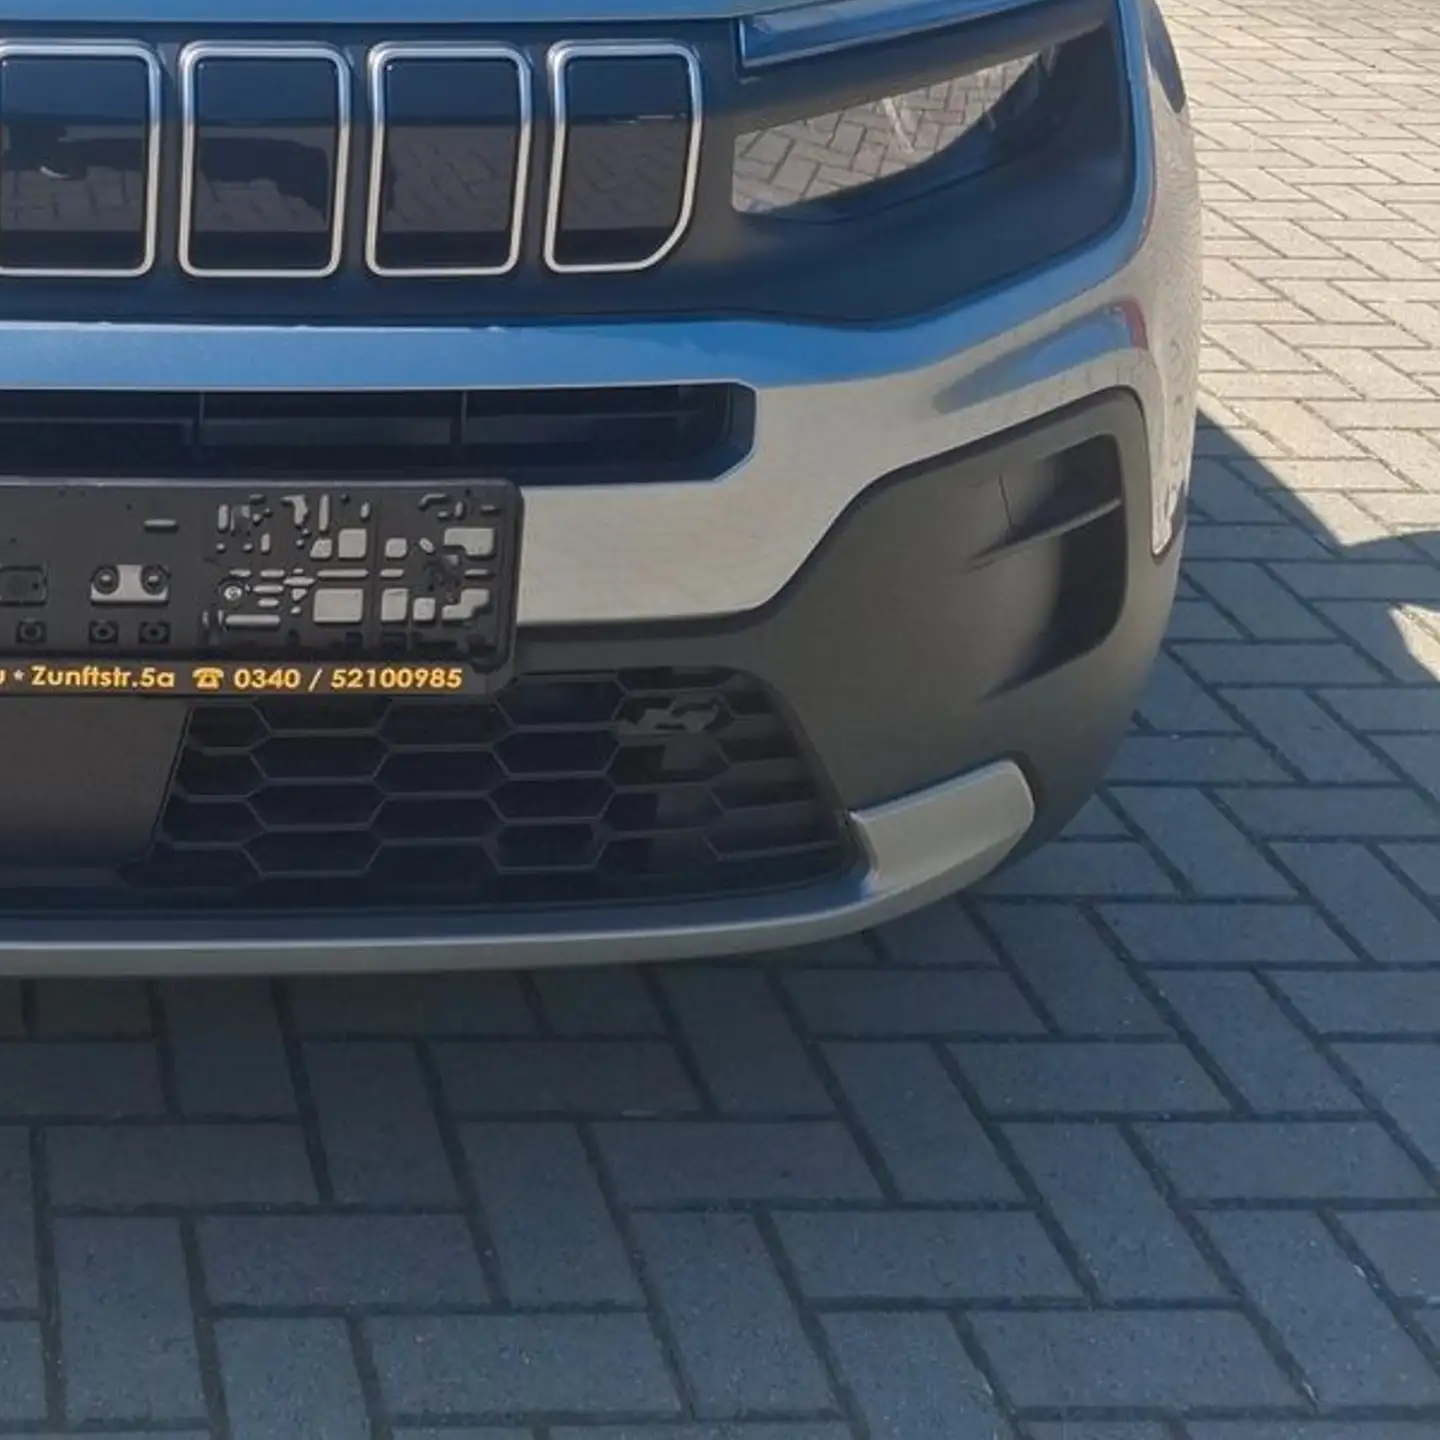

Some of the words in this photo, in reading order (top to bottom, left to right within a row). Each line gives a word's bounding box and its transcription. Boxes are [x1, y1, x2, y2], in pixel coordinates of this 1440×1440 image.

[30, 665, 176, 689] Zunftstr.5a
[233, 667, 301, 690] 0340
[330, 667, 463, 690] 52100985
